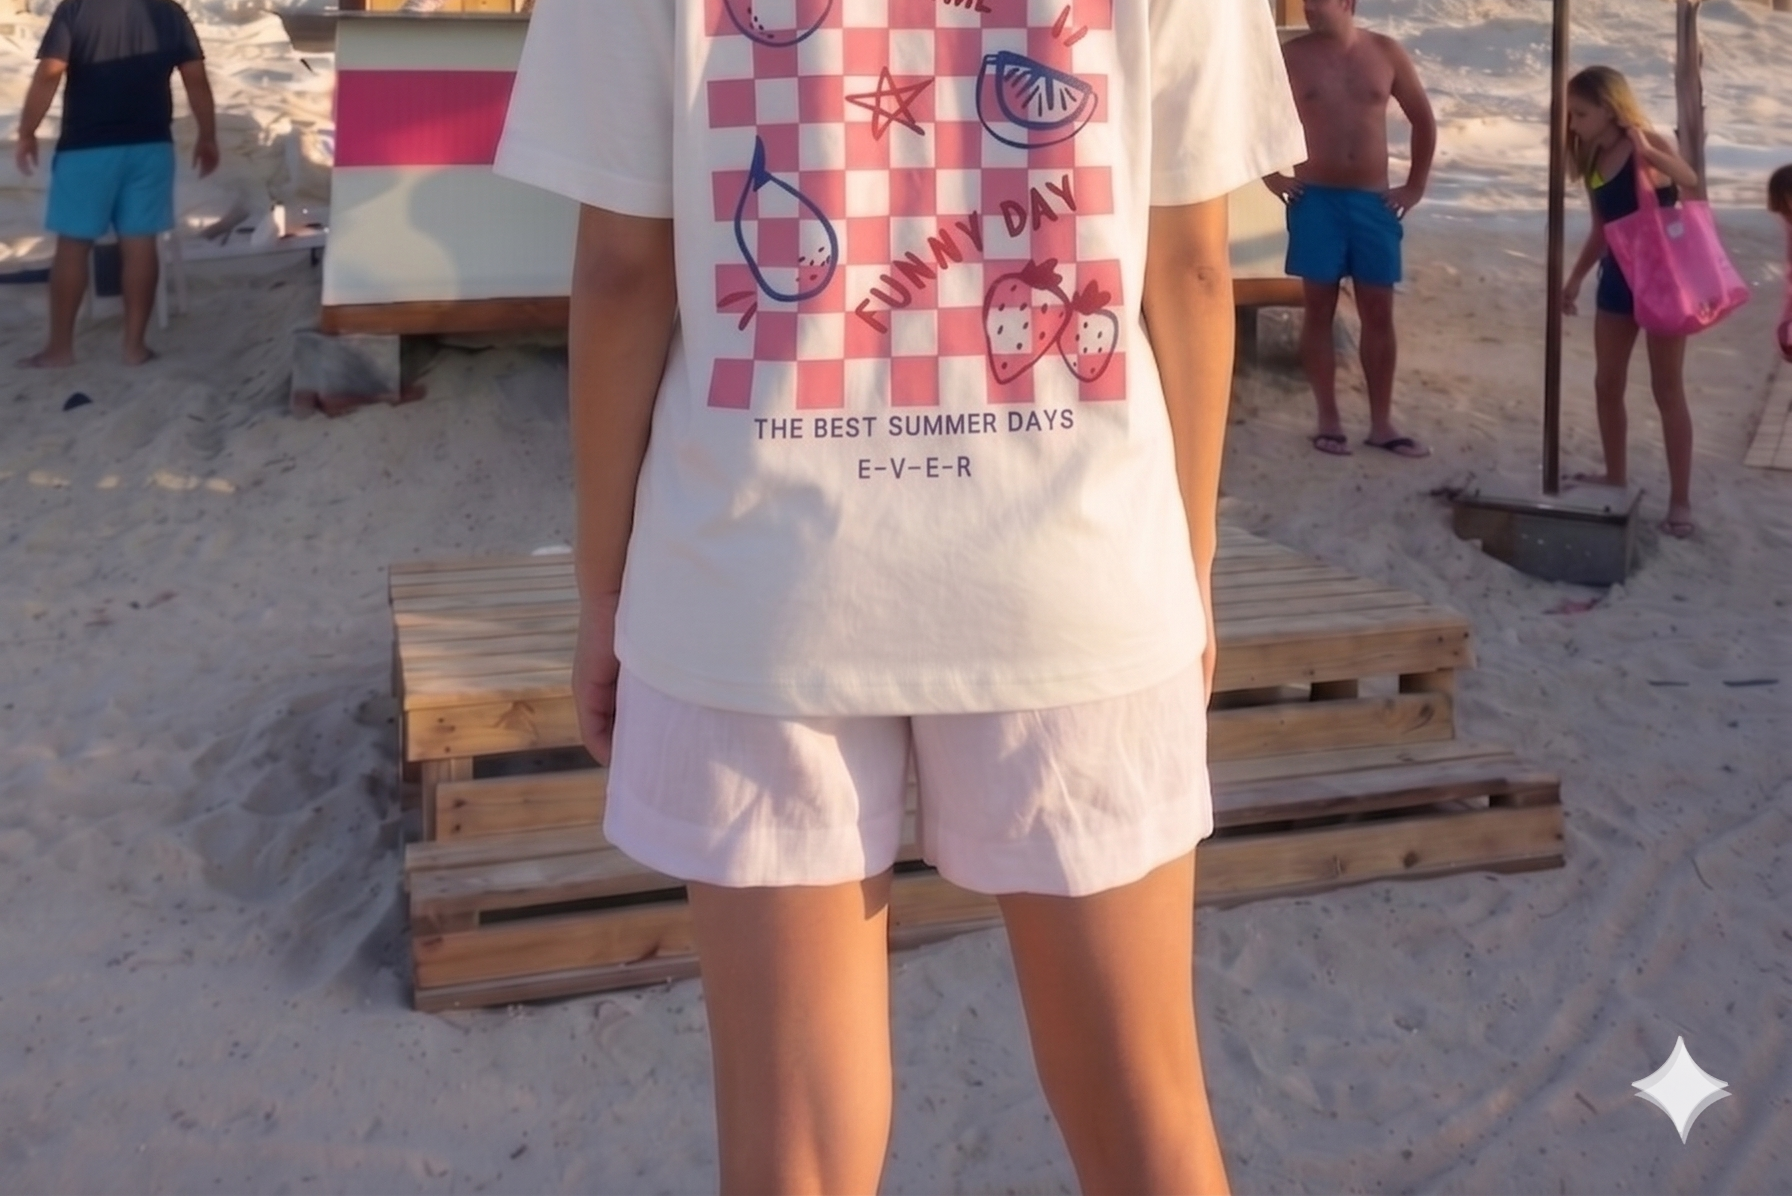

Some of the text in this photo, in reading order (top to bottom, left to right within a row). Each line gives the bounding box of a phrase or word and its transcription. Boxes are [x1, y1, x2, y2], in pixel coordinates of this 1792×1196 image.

[854, 174, 1077, 334] FUNNY DAY
[754, 408, 1075, 440] THE BEST SUMMER DAYS
[858, 456, 972, 480] E-V-E-R
